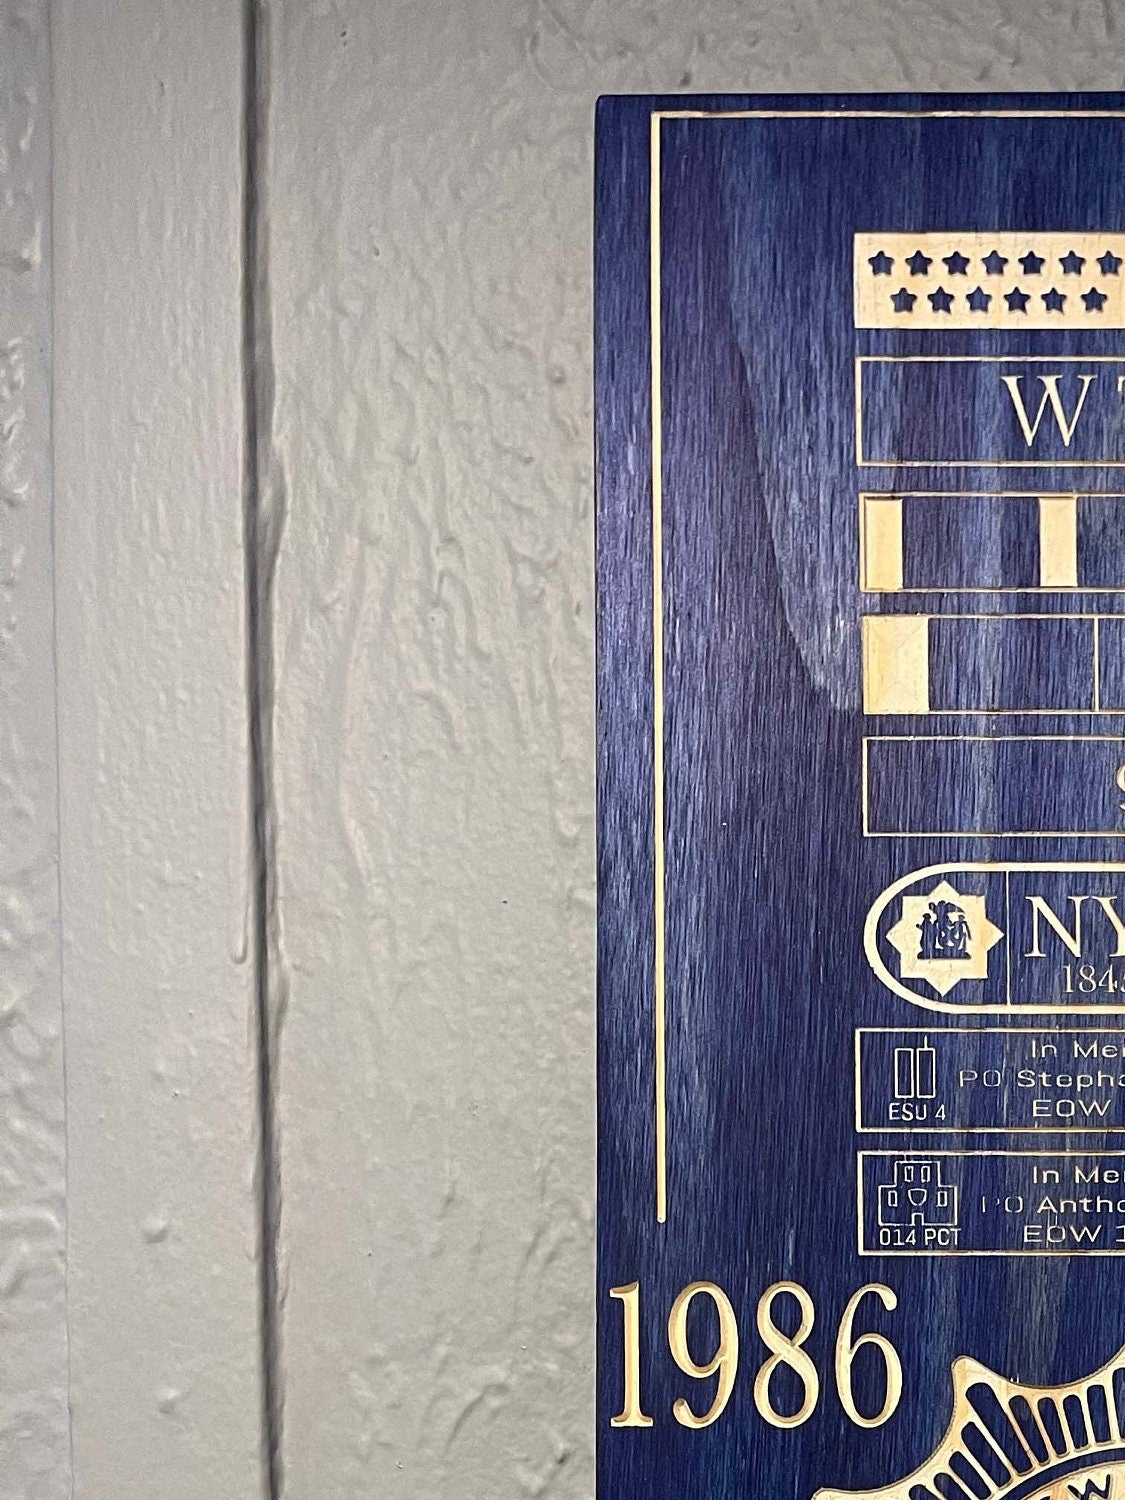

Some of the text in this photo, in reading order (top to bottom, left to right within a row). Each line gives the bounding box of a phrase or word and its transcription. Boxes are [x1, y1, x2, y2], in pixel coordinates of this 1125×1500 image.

[1031, 1040, 1057, 1058] In
[959, 1069, 1001, 1087] PO
[888, 1103, 946, 1121] ESU 4
[1032, 1099, 1111, 1117] EOW
[1032, 1165, 1059, 1184] In
[879, 1228, 962, 1246] 014 PCT
[1023, 1225, 1102, 1243] EOW
[609, 1281, 904, 1430] 1986
